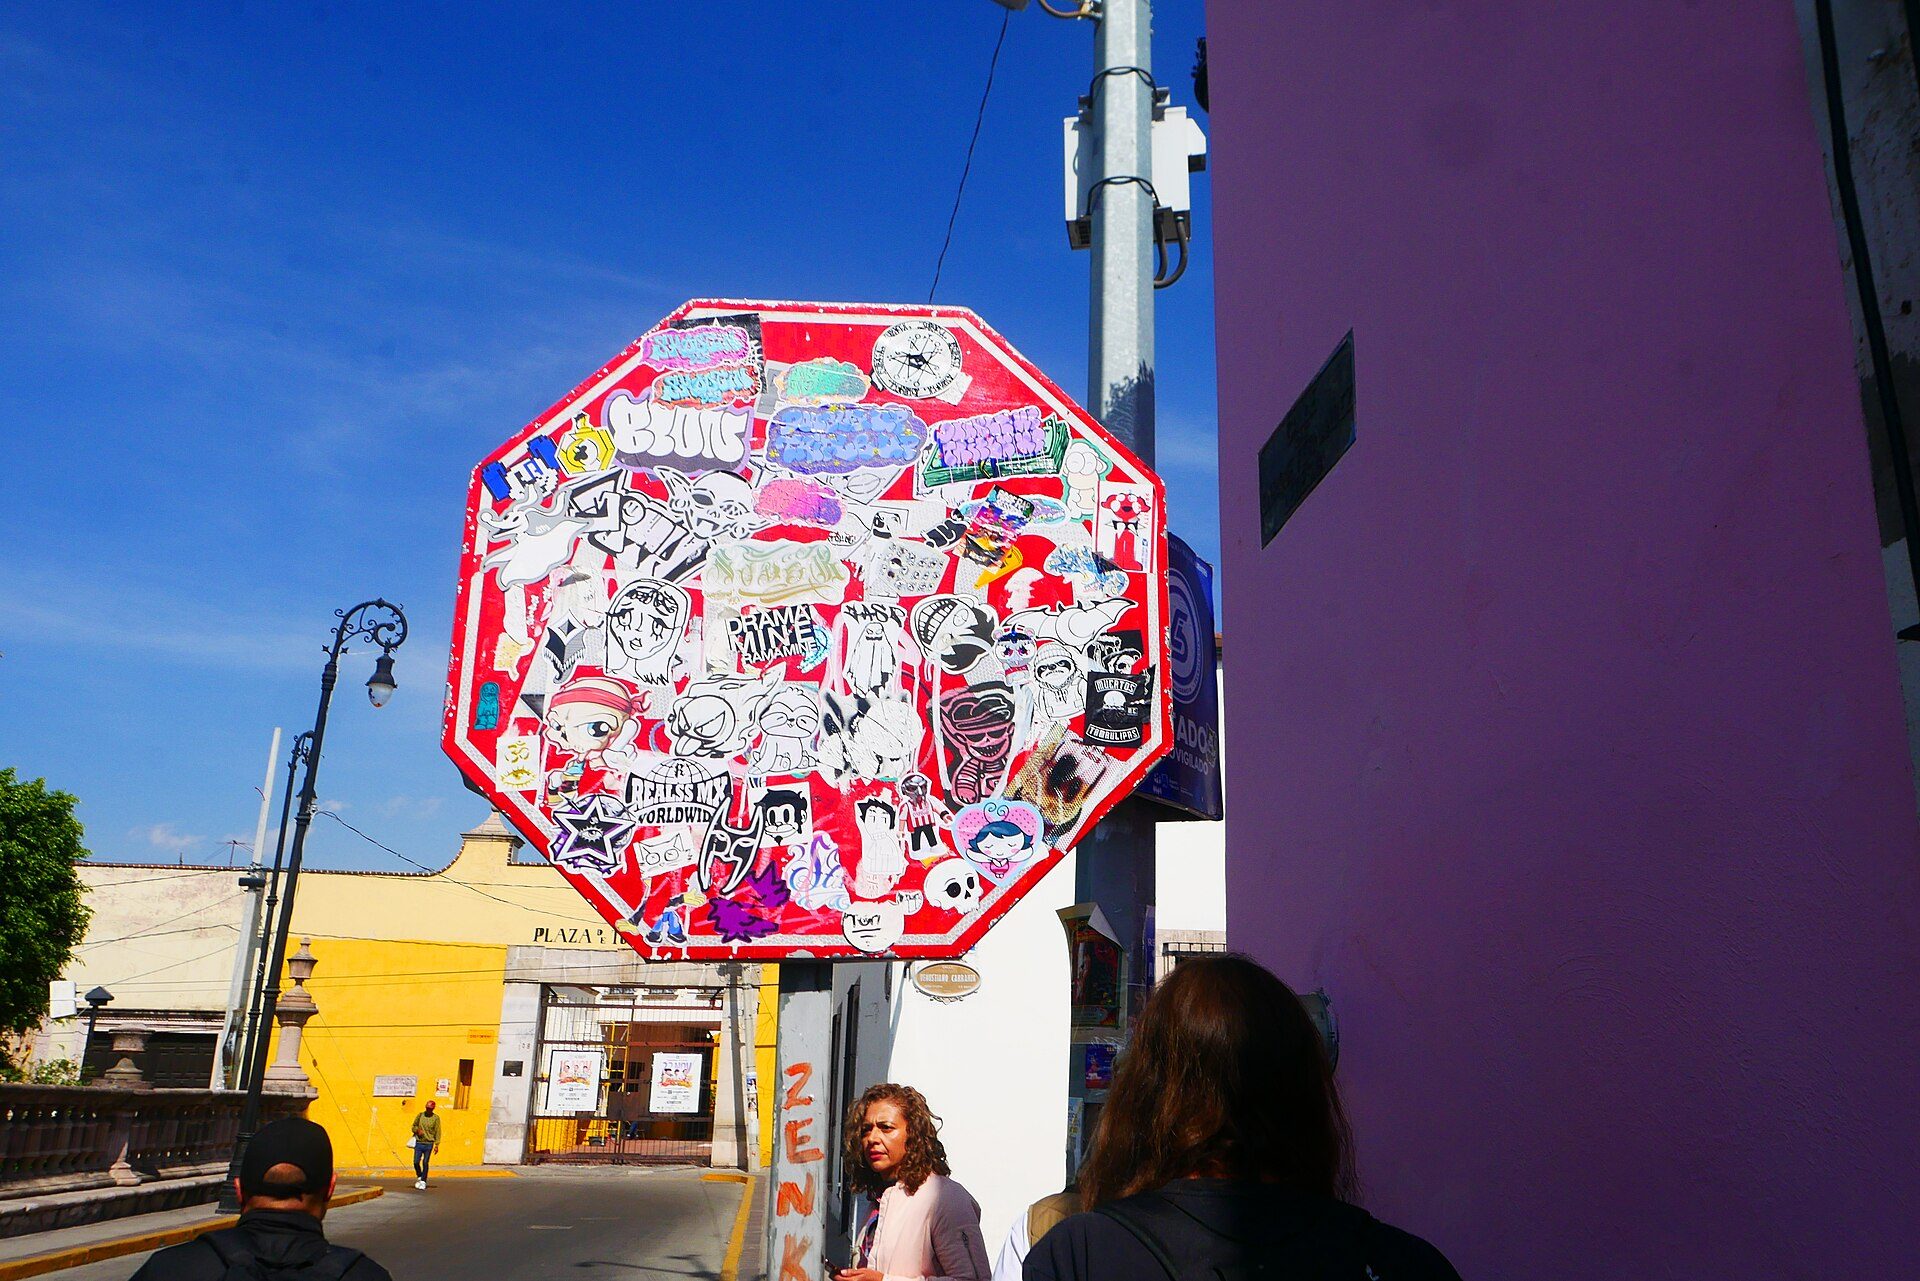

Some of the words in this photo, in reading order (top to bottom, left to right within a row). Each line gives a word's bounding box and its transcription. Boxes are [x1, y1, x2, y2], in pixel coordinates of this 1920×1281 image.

[727, 602, 811, 636] DRAMA
[729, 615, 816, 655] MINE
[1096, 679, 1136, 694] MUERTOS
[1089, 727, 1138, 741] TAMAULIPAS
[631, 779, 696, 804] REALSS
[696, 775, 729, 806] MX
[637, 806, 714, 823] WORLDWID
[533, 927, 592, 945] PLAZA
[776, 1062, 825, 1281] ZENK
